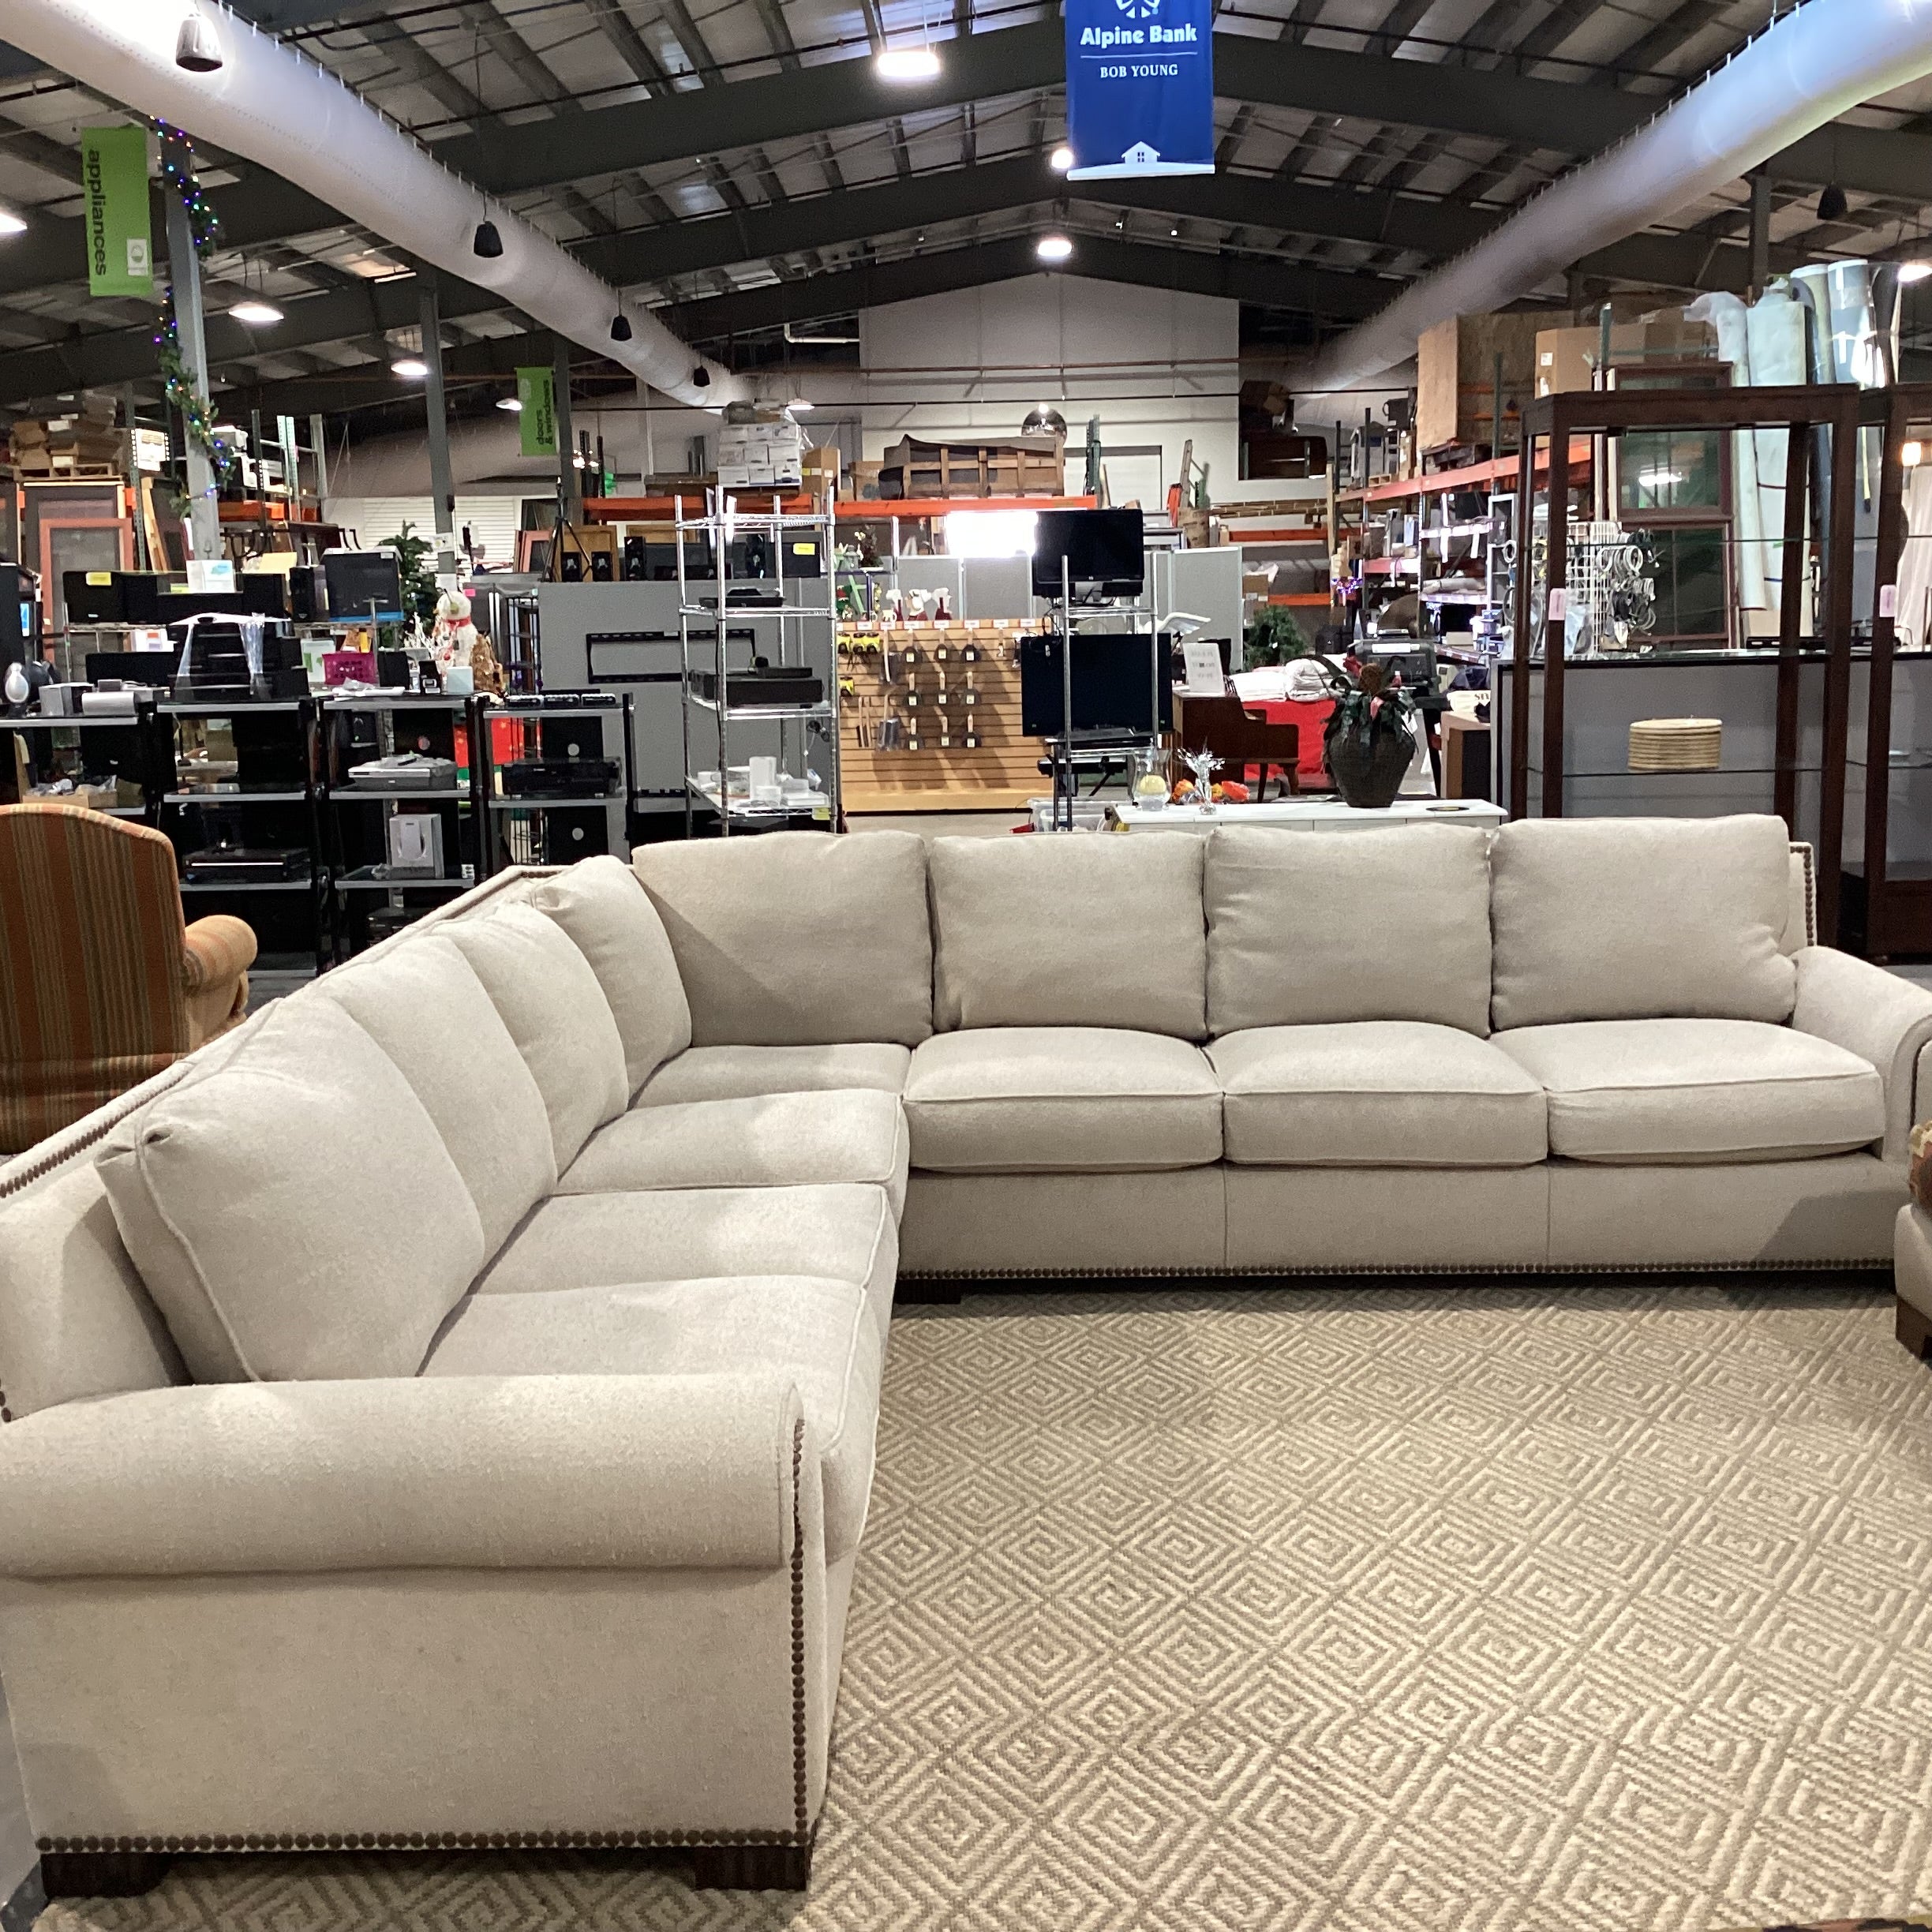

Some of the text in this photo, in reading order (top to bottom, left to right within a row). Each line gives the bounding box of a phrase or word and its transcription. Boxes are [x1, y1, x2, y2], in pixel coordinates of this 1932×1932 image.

[1080, 23, 1197, 49] Alpine Bank
[1100, 64, 1178, 78] BOB YOUNG
[87, 148, 107, 276] appliances
